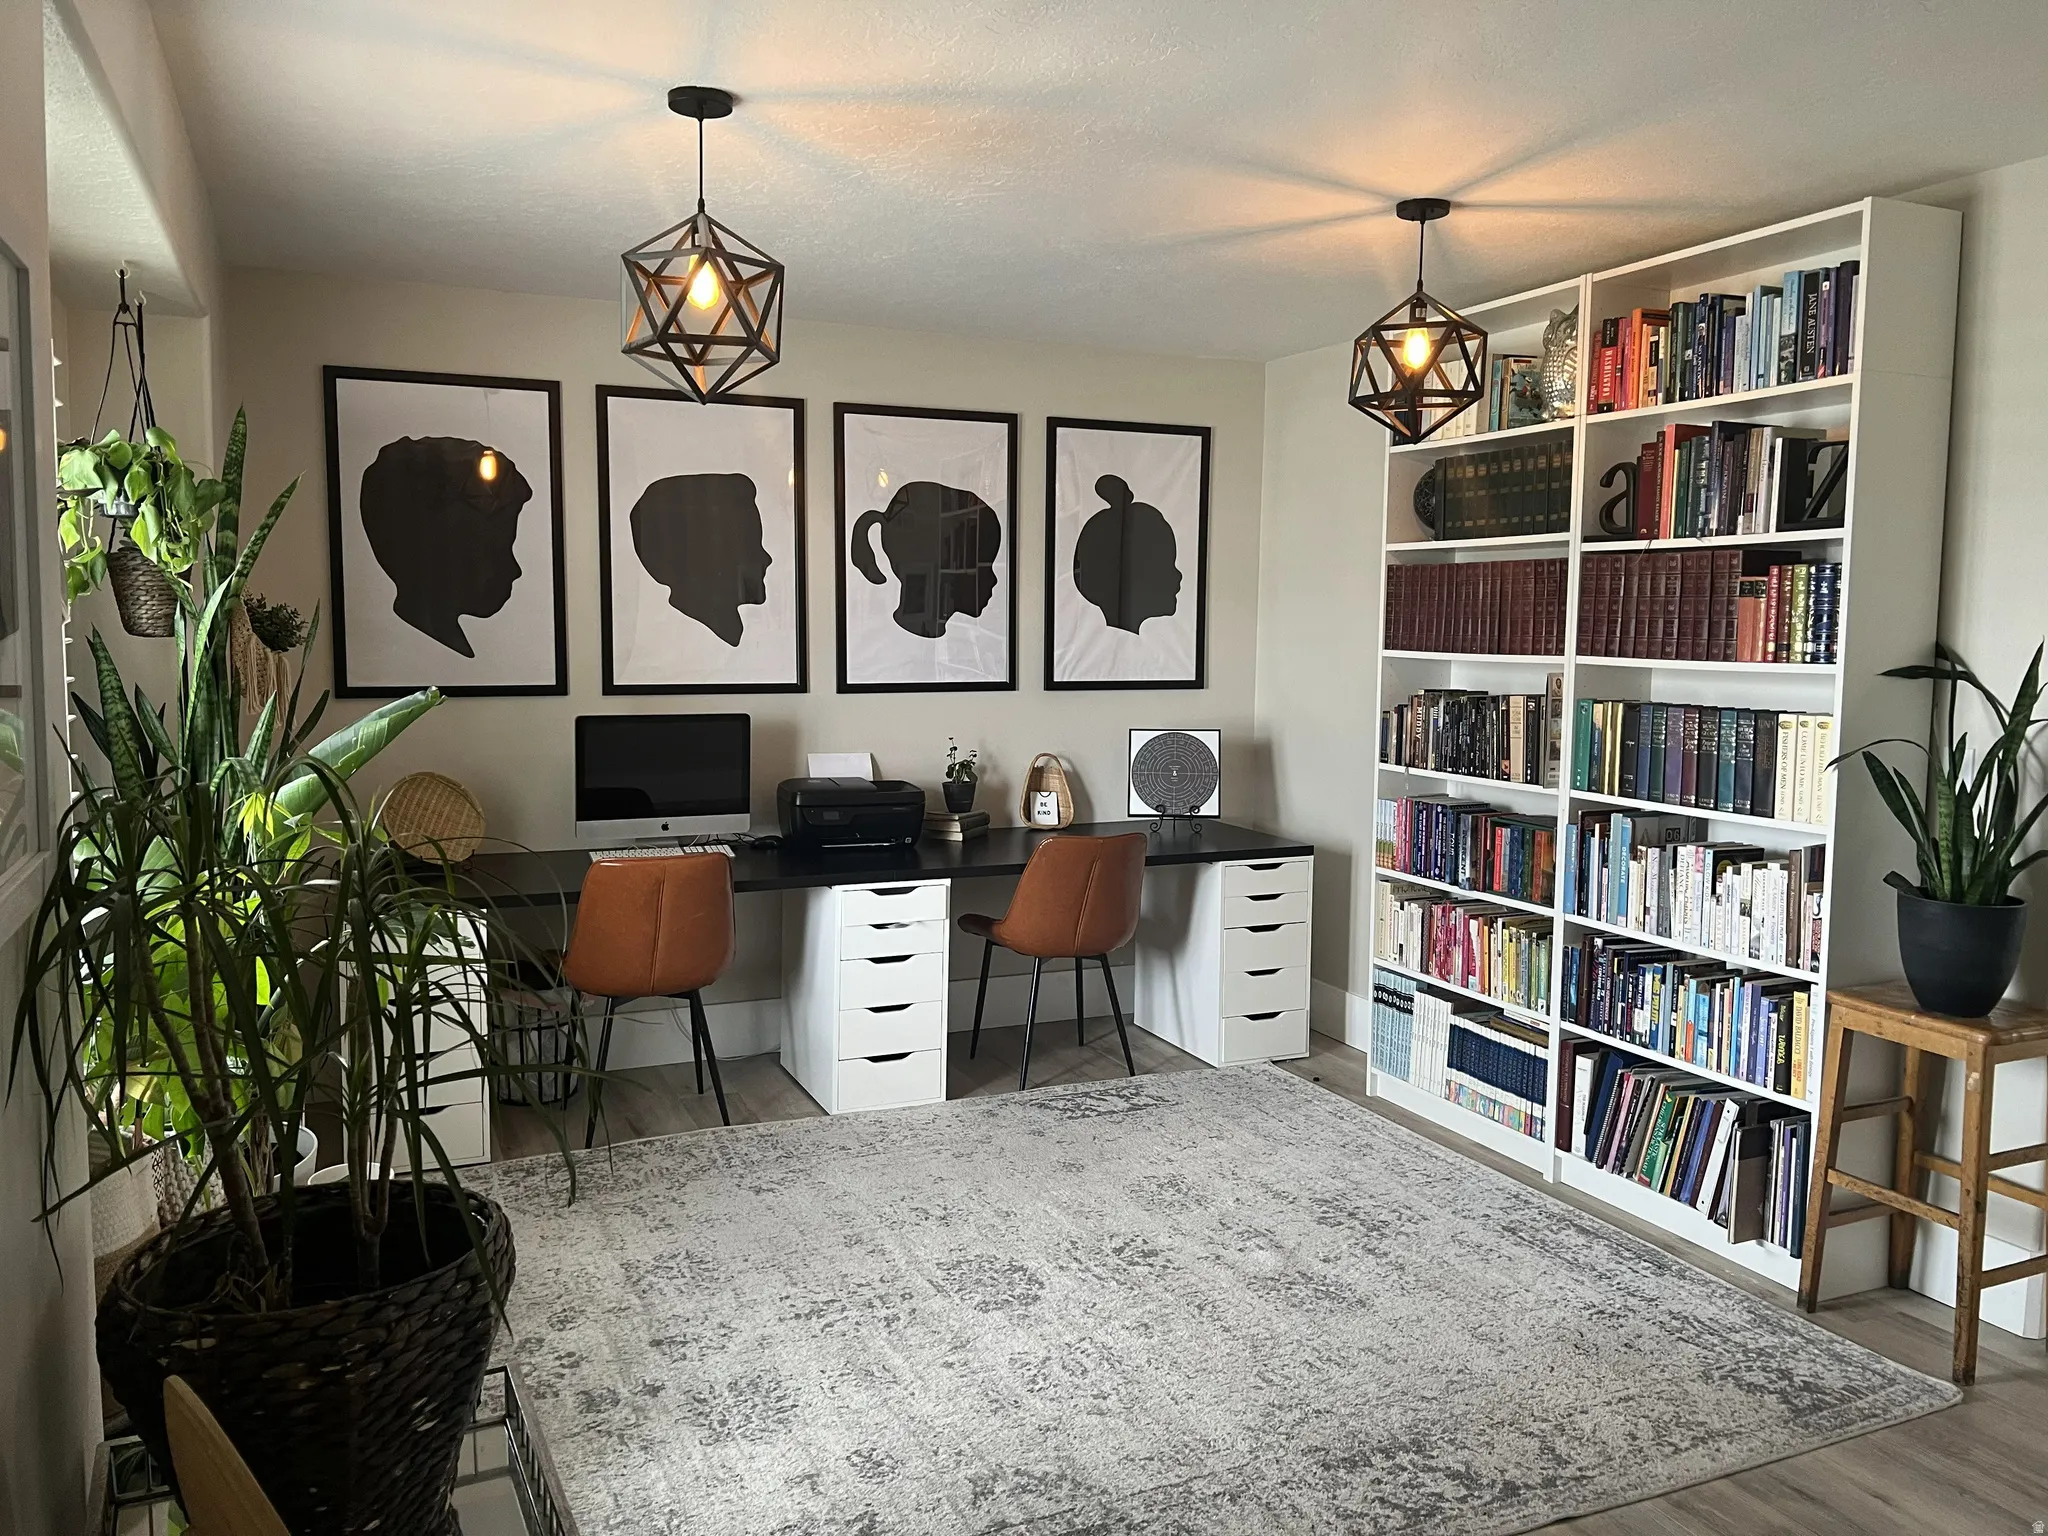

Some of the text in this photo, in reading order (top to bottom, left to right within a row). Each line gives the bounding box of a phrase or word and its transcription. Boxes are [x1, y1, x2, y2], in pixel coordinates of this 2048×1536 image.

[1806, 293, 1818, 354] JANE AUSTEN
[1603, 350, 1613, 397] WASHINGTON
[1415, 706, 1423, 739] MUDDY
[1781, 731, 1789, 761] FISHERS
[1799, 754, 1807, 776] UNTO
[1794, 1006, 1803, 1055] DAVID BALDACCI
[1776, 1034, 1786, 1064] WONDER
